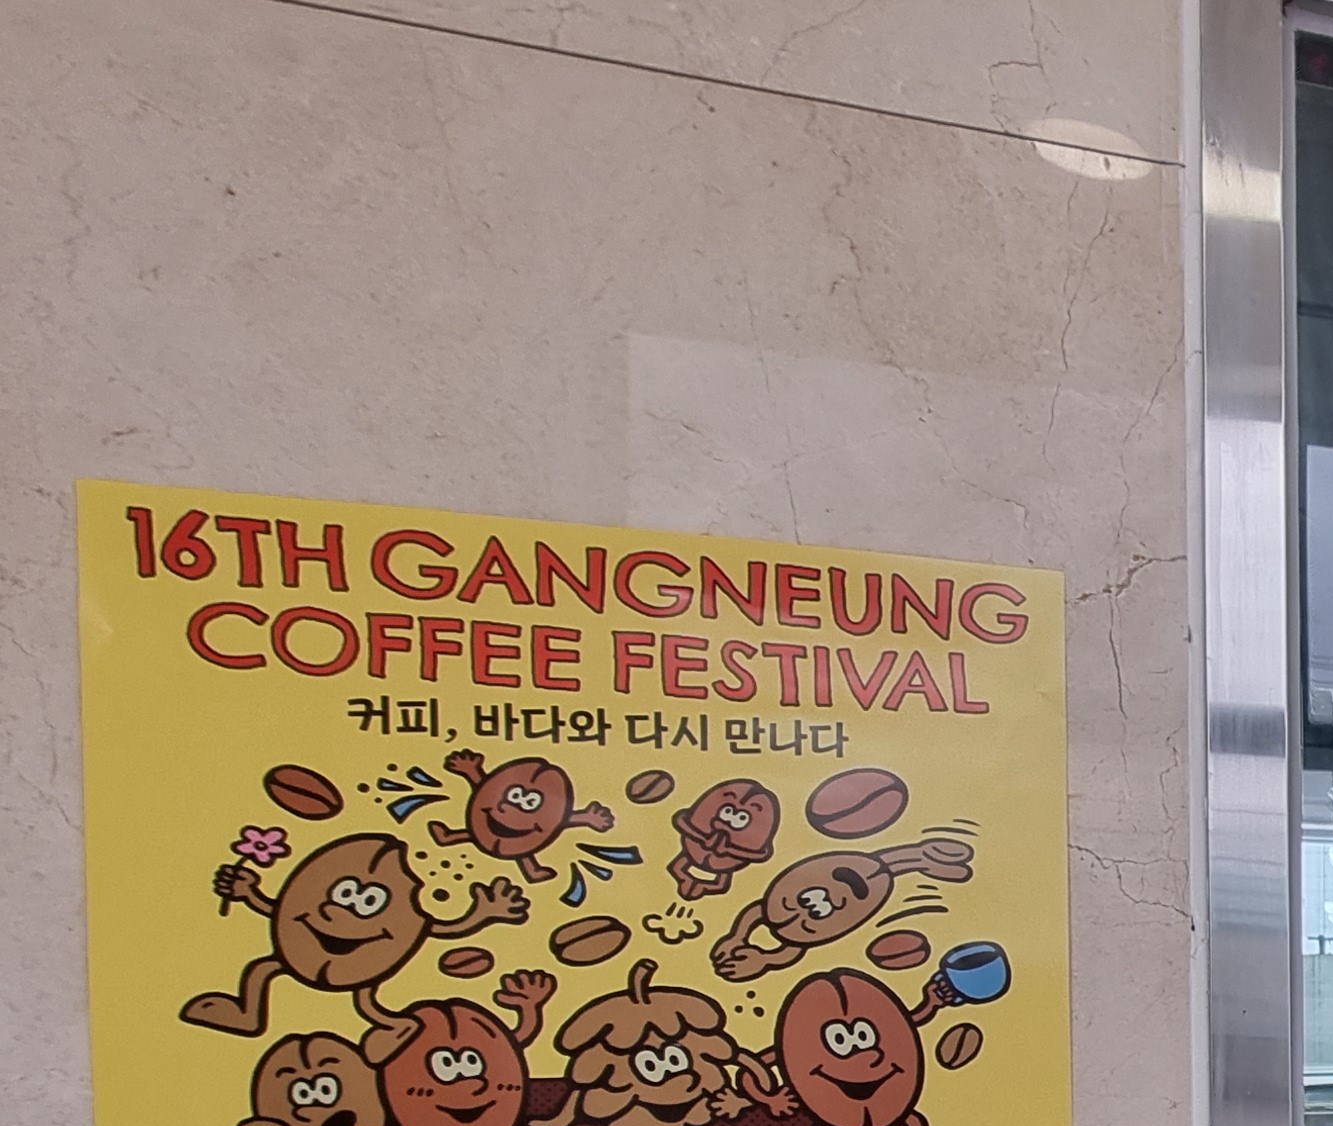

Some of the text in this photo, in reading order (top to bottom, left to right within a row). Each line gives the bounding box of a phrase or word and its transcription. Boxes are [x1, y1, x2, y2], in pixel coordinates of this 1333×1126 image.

[125, 506, 1030, 648] 16TH GANGNEUNG
[186, 602, 991, 716] COFFEE FESTIVAL
[347, 695, 850, 760] 커피, 바다와 다시 만나다
